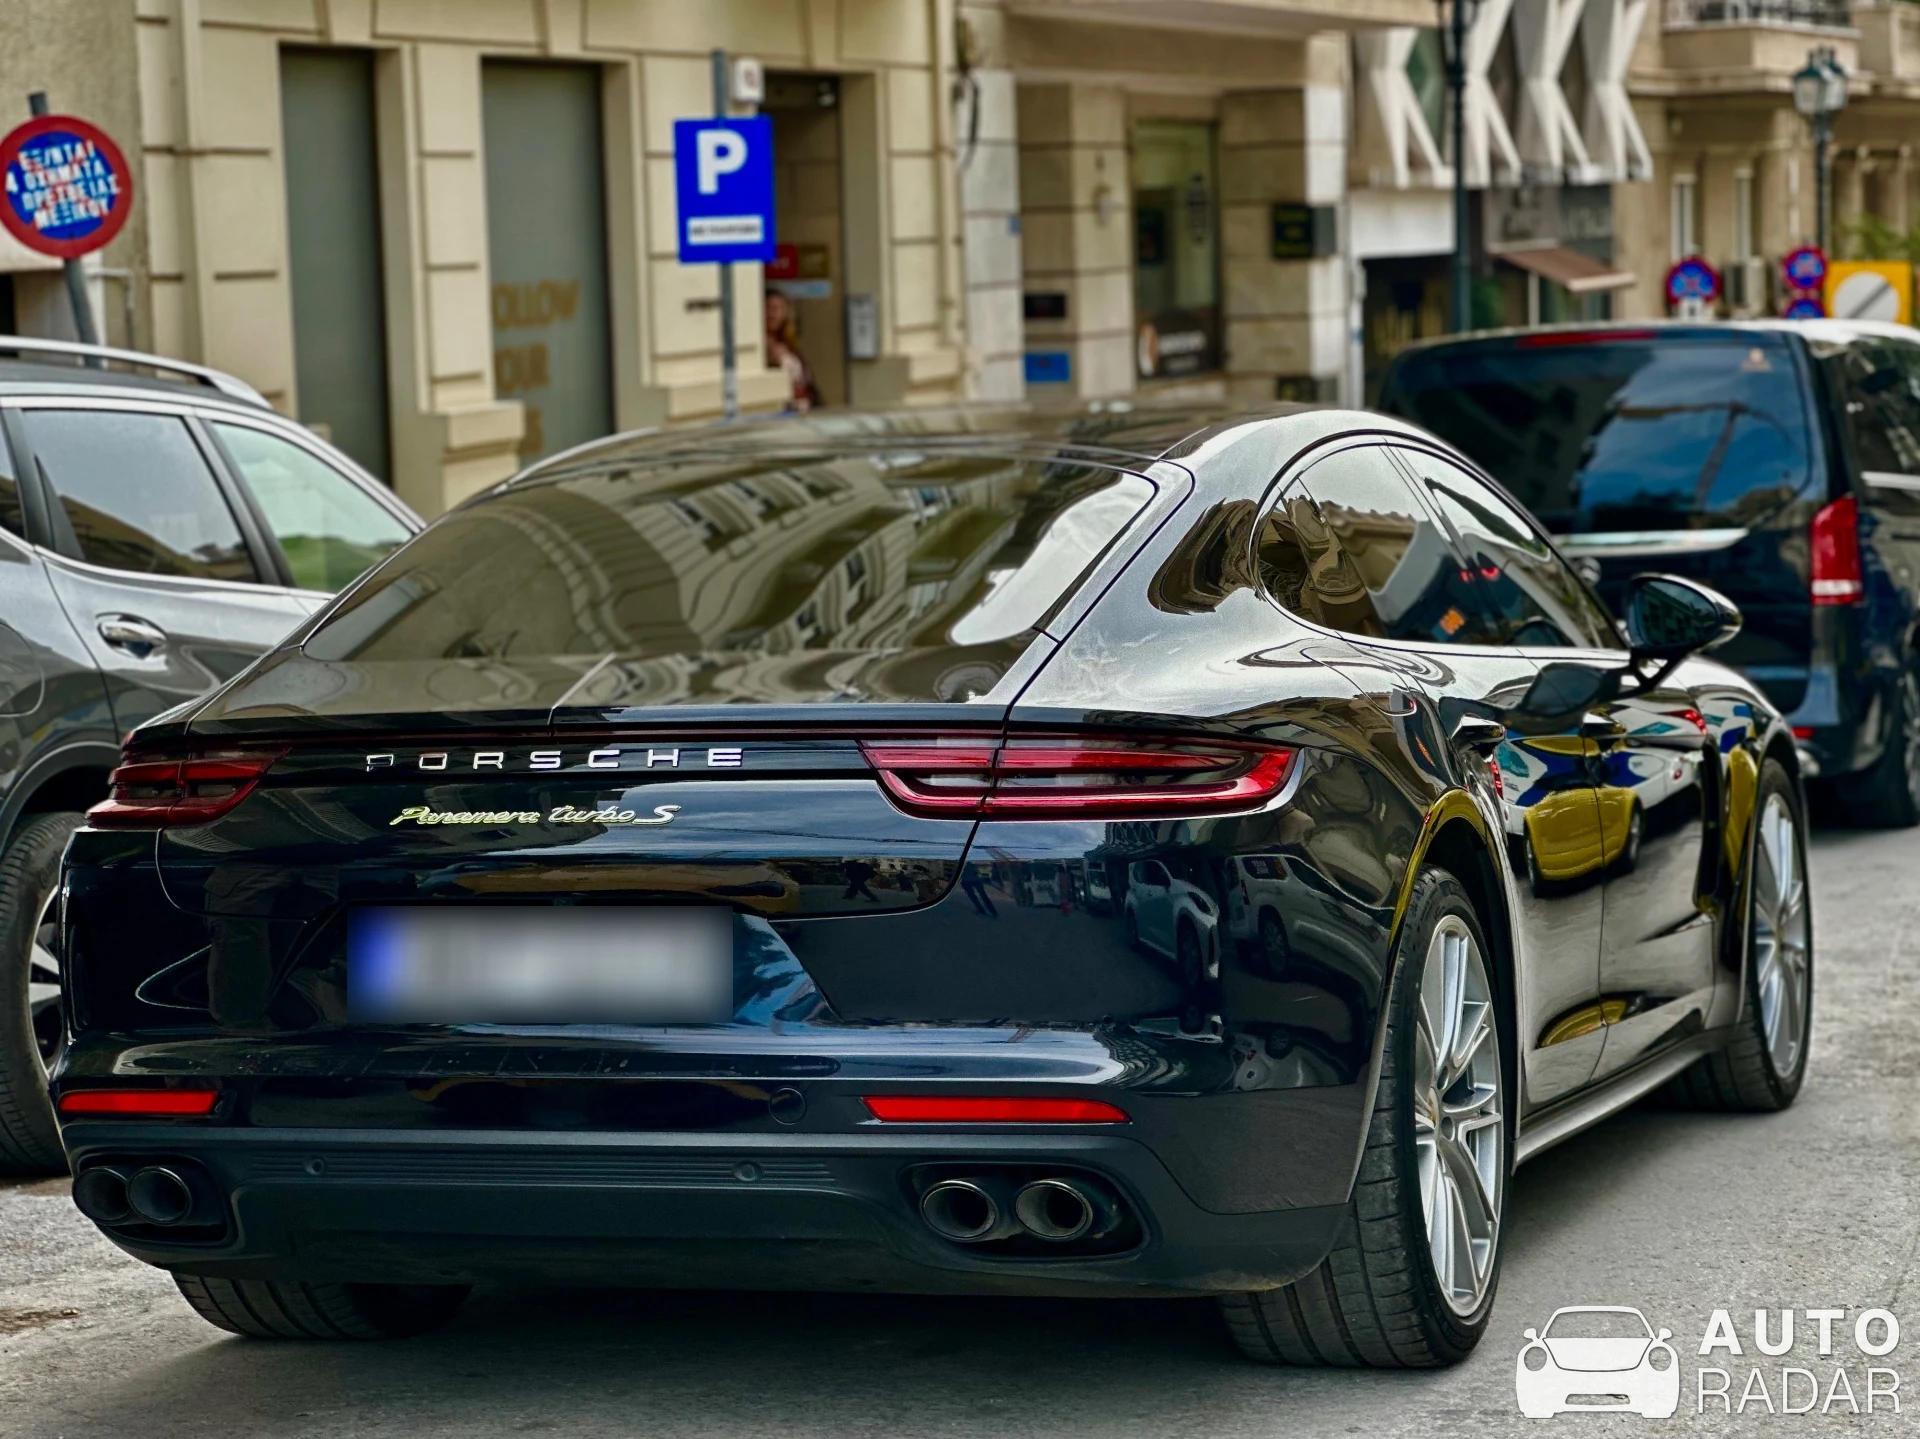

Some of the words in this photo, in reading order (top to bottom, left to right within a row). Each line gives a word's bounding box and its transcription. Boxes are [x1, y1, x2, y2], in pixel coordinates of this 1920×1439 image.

[697, 129, 748, 195] P
[493, 279, 580, 331] OLLOW
[366, 748, 743, 772] PORSCHE
[389, 805, 540, 826] Panamera
[548, 804, 637, 824] turbo
[631, 804, 683, 825] S
